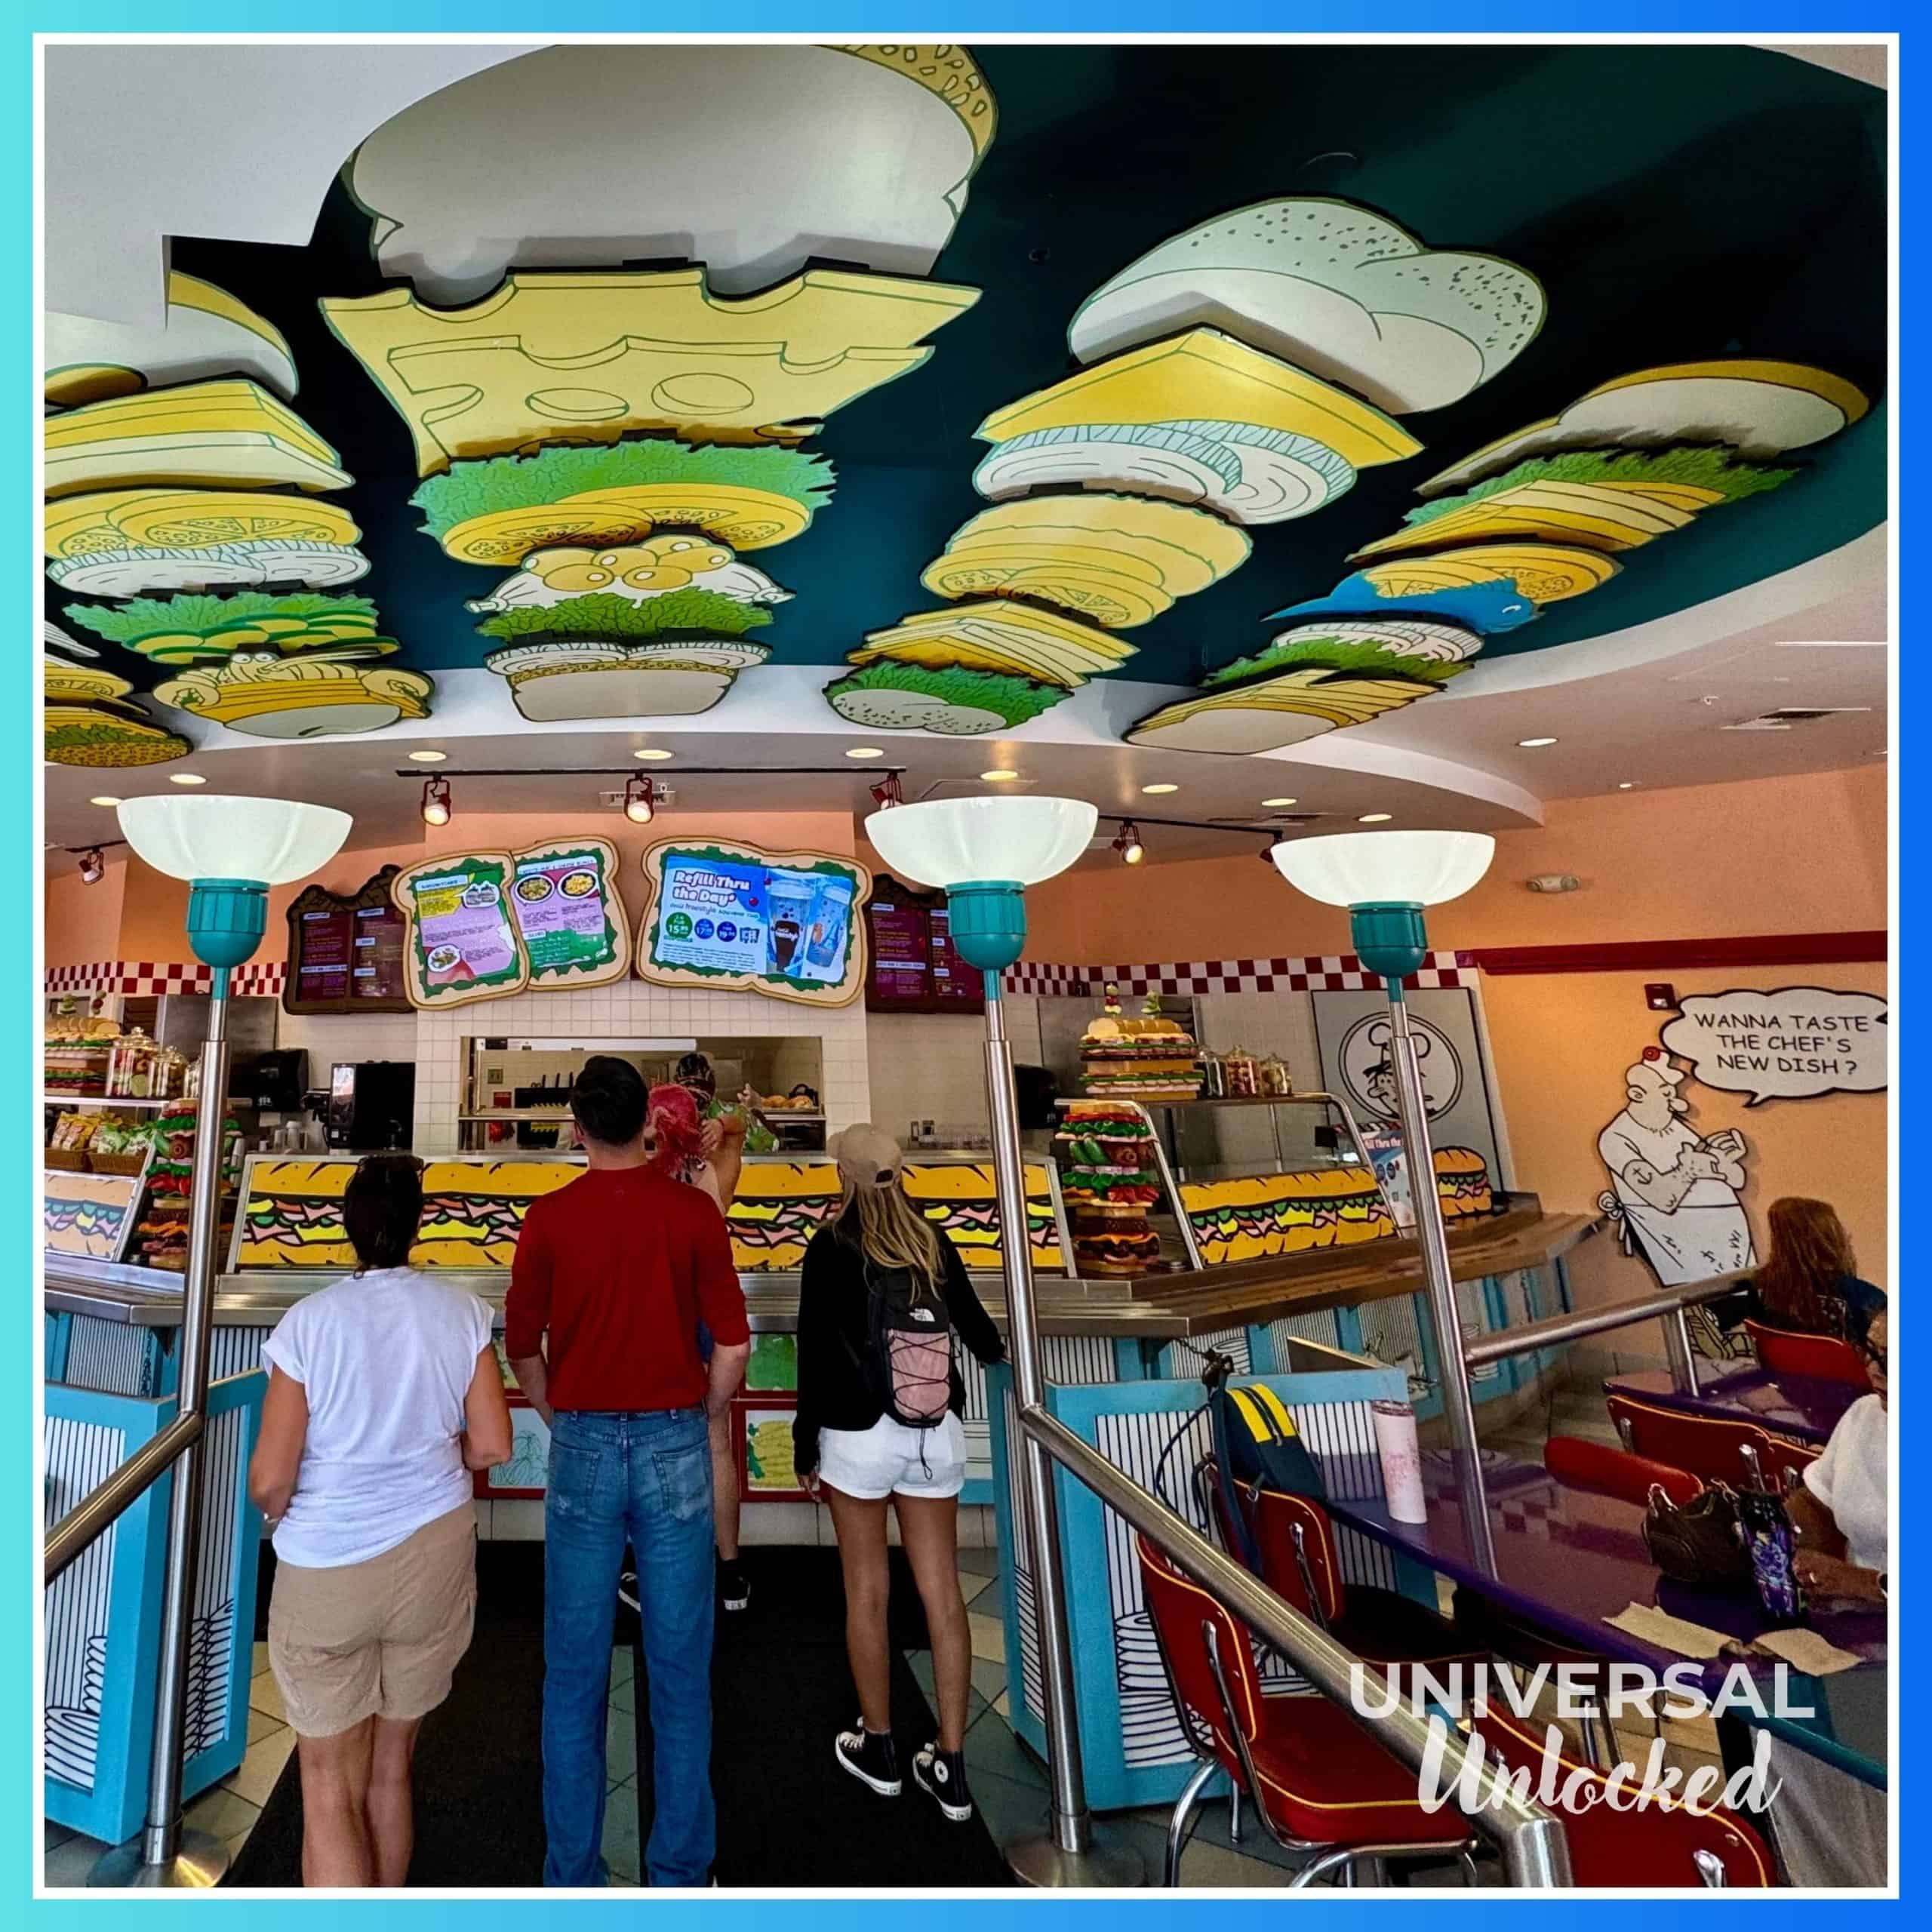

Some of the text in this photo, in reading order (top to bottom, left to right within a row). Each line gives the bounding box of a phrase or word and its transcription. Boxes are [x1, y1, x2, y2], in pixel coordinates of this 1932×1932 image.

[674, 870, 750, 891] Refill Thru
[673, 887, 697, 900] the
[1694, 1013, 1869, 1032] WANNA TASTE
[1716, 1034, 1851, 1053] THE CHEF'S
[1717, 1054, 1769, 1071] NEW
